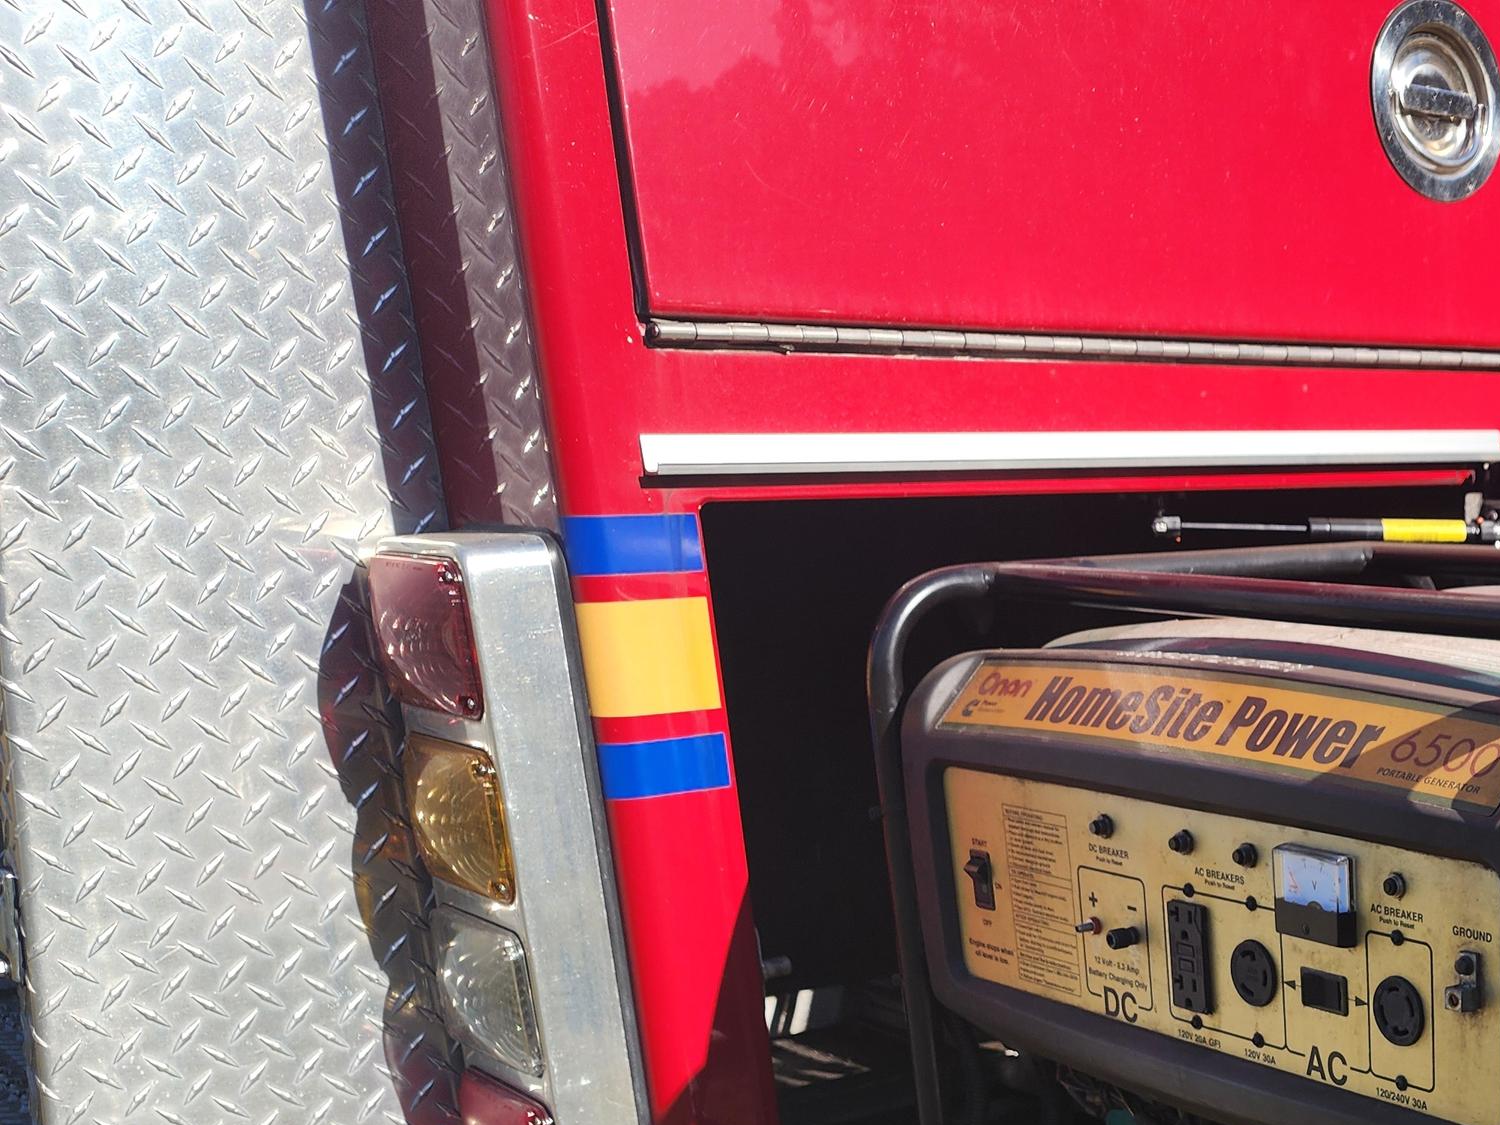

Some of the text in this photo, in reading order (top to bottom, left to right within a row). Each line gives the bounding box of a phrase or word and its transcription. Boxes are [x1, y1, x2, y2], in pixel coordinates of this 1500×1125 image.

[978, 672, 1033, 697] Onan
[1024, 675, 1386, 769] HomeSite Power
[1376, 767, 1480, 794] PORTABLE GENERATOR
[1088, 842, 1129, 859] DC BREAKER
[1194, 866, 1245, 885] AC BREAKERS
[1370, 903, 1424, 922] AC BREAKER
[1379, 916, 1393, 925] Push
[1400, 920, 1415, 929] Reset
[1452, 926, 1492, 943] GROUND
[1094, 955, 1101, 964] 12
[1127, 964, 1140, 975] Amp
[1089, 966, 1148, 992] Battery Charging Only
[1103, 985, 1138, 1023] DC
[1177, 1028, 1221, 1049] 120V 20A GFI
[1244, 1048, 1276, 1065] 120V 30A
[1306, 1045, 1348, 1086] AC
[1375, 1087, 1427, 1111] 120/240V 30A
